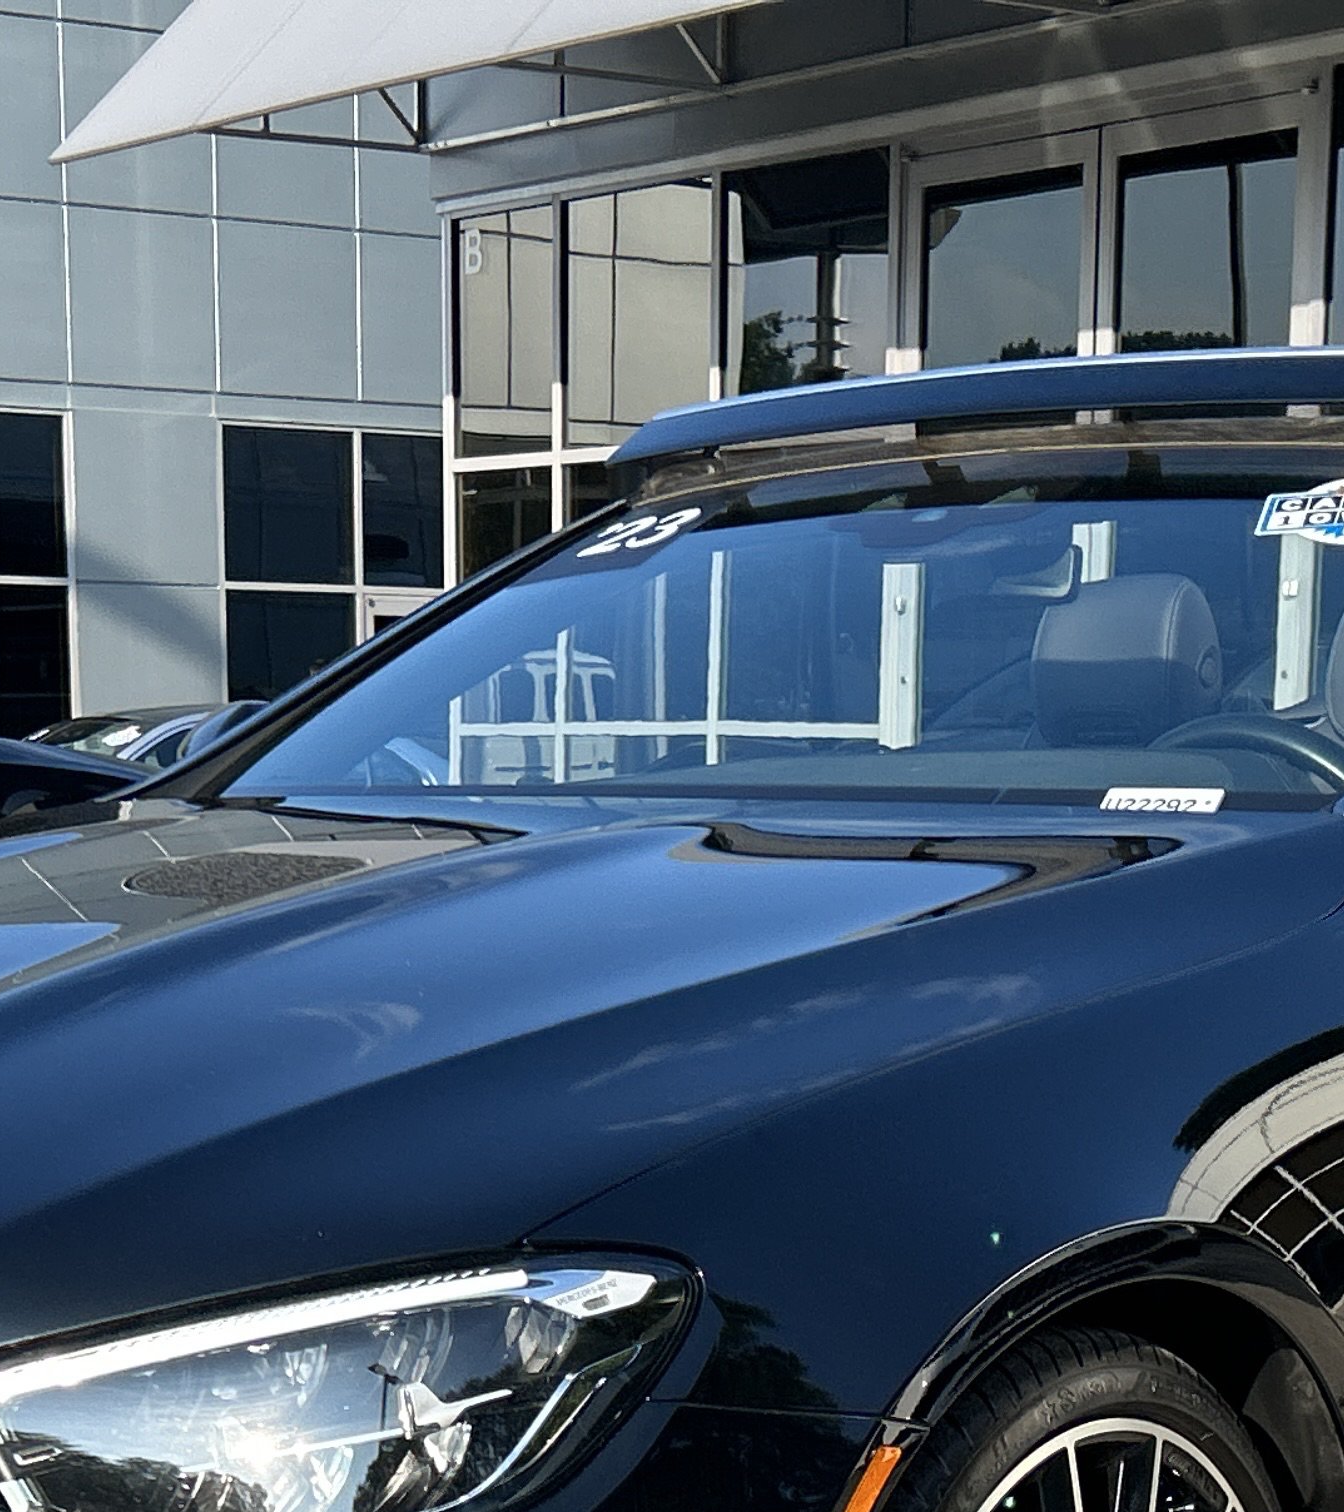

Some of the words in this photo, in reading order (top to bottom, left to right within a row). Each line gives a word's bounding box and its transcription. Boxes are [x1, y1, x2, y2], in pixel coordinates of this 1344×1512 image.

[464, 228, 483, 275] B
[576, 507, 702, 557] 23
[1277, 511, 1292, 526] 1
